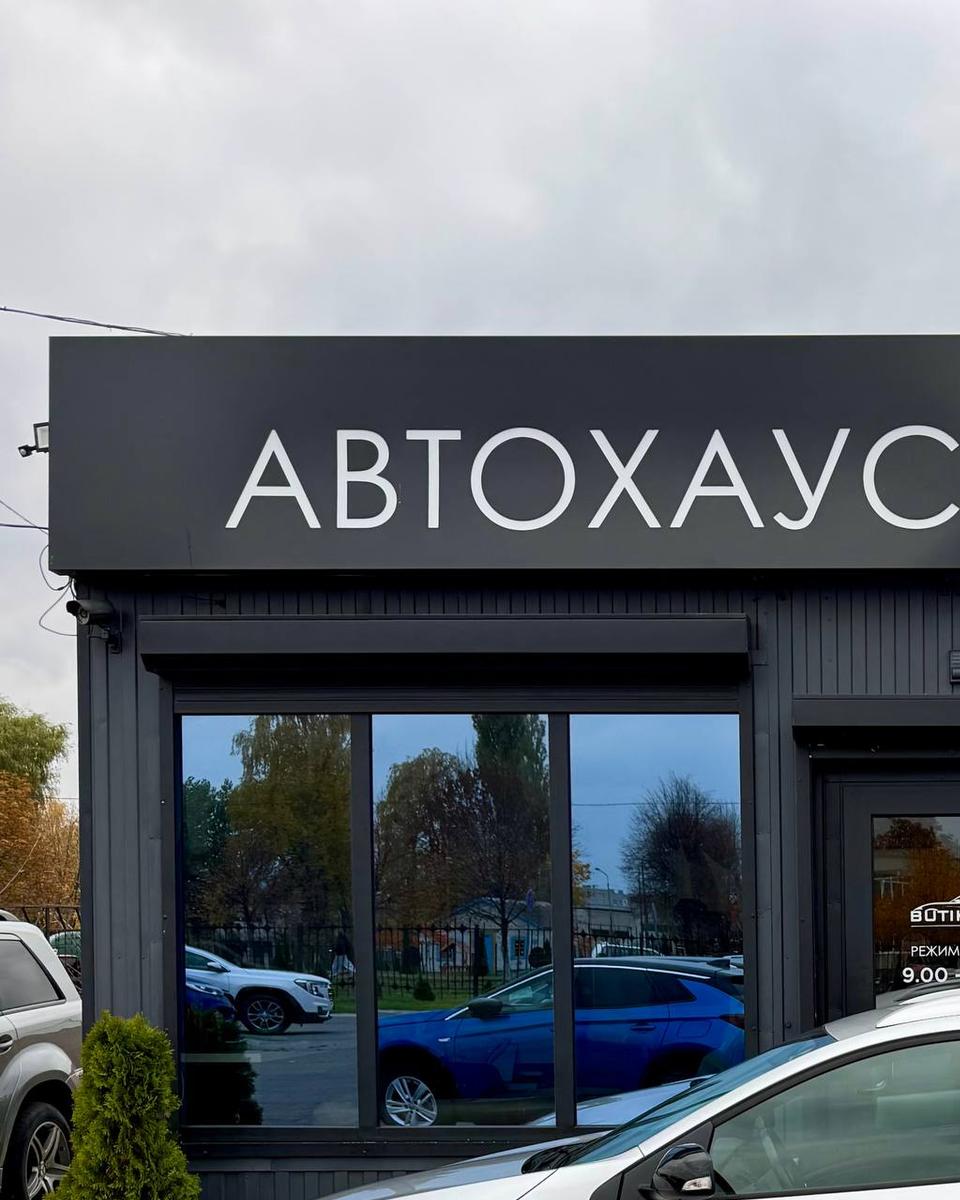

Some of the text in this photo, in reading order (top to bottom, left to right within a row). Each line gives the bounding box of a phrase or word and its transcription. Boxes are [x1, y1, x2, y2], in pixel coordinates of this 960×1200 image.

[225, 425, 960, 531] АВТОХАУС
[910, 945, 960, 958] РЕЖИМ
[902, 966, 949, 984] 9.00
